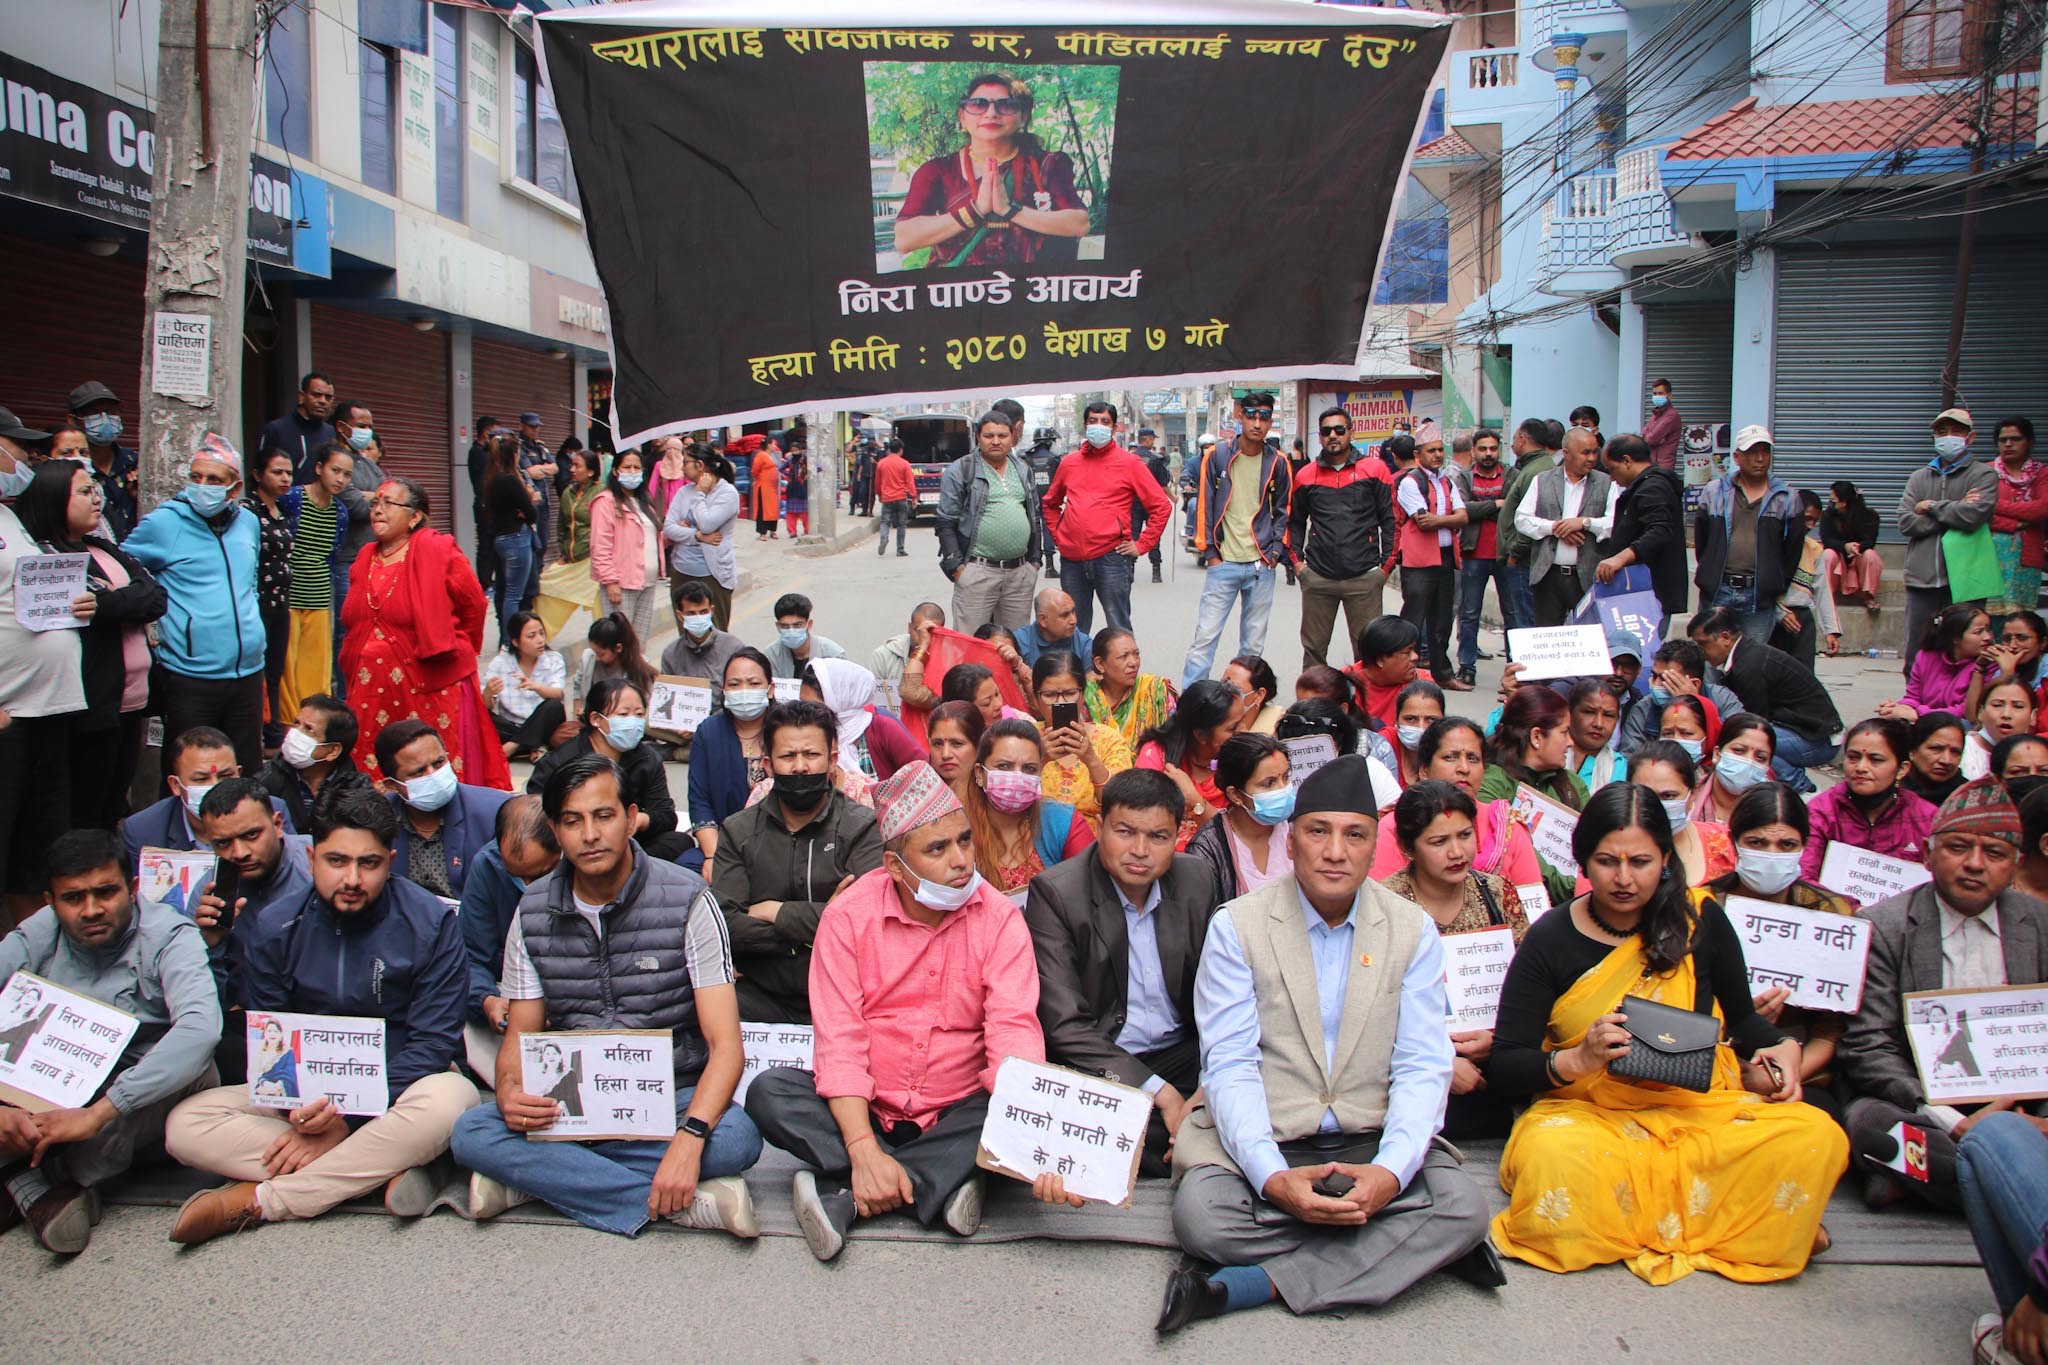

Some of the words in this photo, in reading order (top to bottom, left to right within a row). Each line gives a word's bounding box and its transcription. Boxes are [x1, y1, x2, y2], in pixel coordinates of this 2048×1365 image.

[1245, 38, 1330, 58] न्याय
[838, 277, 916, 316] निरा
[927, 272, 1015, 308] पाण्डे
[1026, 269, 1142, 303] आचार्य
[173, 318, 206, 335] पेन्टर
[748, 350, 817, 387] हत्या
[829, 335, 900, 374] मिति
[946, 337, 1026, 371] २०८०
[1043, 320, 1131, 359] वैशाख
[1146, 326, 1167, 352] ७
[1184, 318, 1229, 348] गते
[1372, 391, 1393, 399] WINTER
[1034, 478, 1050, 486] POLICE
[1745, 913, 1802, 945] गुन्डा
[1813, 924, 1857, 951] गर्दी
[1816, 978, 1849, 1002] गर
[59, 1006, 88, 1030] निरा
[89, 1021, 122, 1044] पाण्डे
[303, 1028, 383, 1049] हत्यारालाई
[778, 1032, 812, 1046] सम्म
[603, 1043, 652, 1063] महिला
[30, 1059, 62, 1079] न्याय
[306, 1057, 381, 1078] सार्वजनिक
[594, 1075, 629, 1093] हिंसा
[636, 1077, 665, 1096] बन्द
[1032, 1076, 1070, 1099] आज
[1078, 1088, 1122, 1113] सम्म
[612, 1107, 637, 1124] गर
[1005, 1104, 1053, 1132] भएको
[1062, 1121, 1109, 1147] प्रगती
[1116, 1132, 1134, 1153] के
[1033, 1146, 1050, 1166] के
[1057, 1155, 1076, 1175] हो
